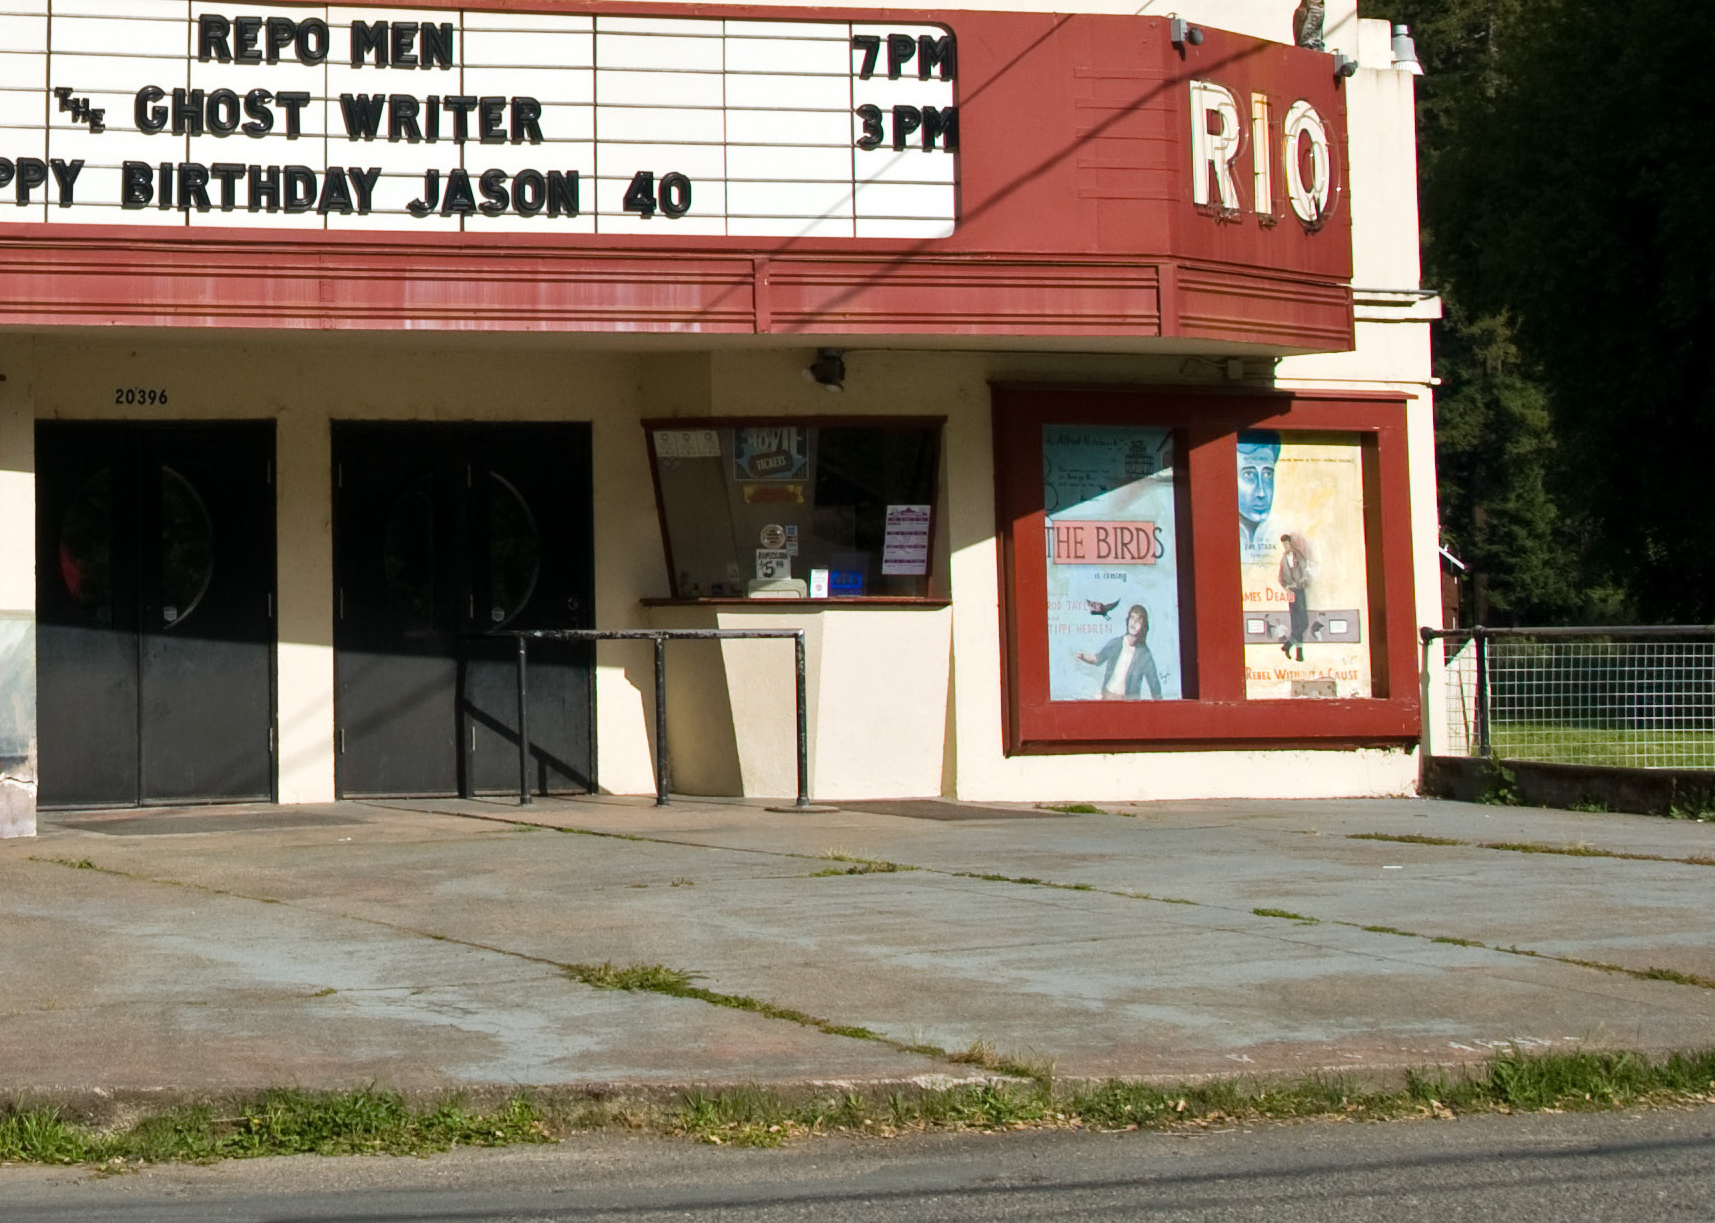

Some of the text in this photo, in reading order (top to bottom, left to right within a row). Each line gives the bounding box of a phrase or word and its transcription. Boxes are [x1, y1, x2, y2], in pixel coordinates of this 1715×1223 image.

[197, 14, 454, 70] REPO MEN
[853, 34, 957, 82] 7PM
[54, 85, 544, 146] THE GHOST WRITER
[854, 103, 958, 153] 3PM
[1189, 79, 1334, 223] RIO
[121, 160, 382, 216] BIRTHDAY
[406, 168, 580, 218] JASON
[622, 171, 693, 219] 40
[114, 387, 169, 406] 20396
[1045, 526, 1166, 561] THE BIRDS
